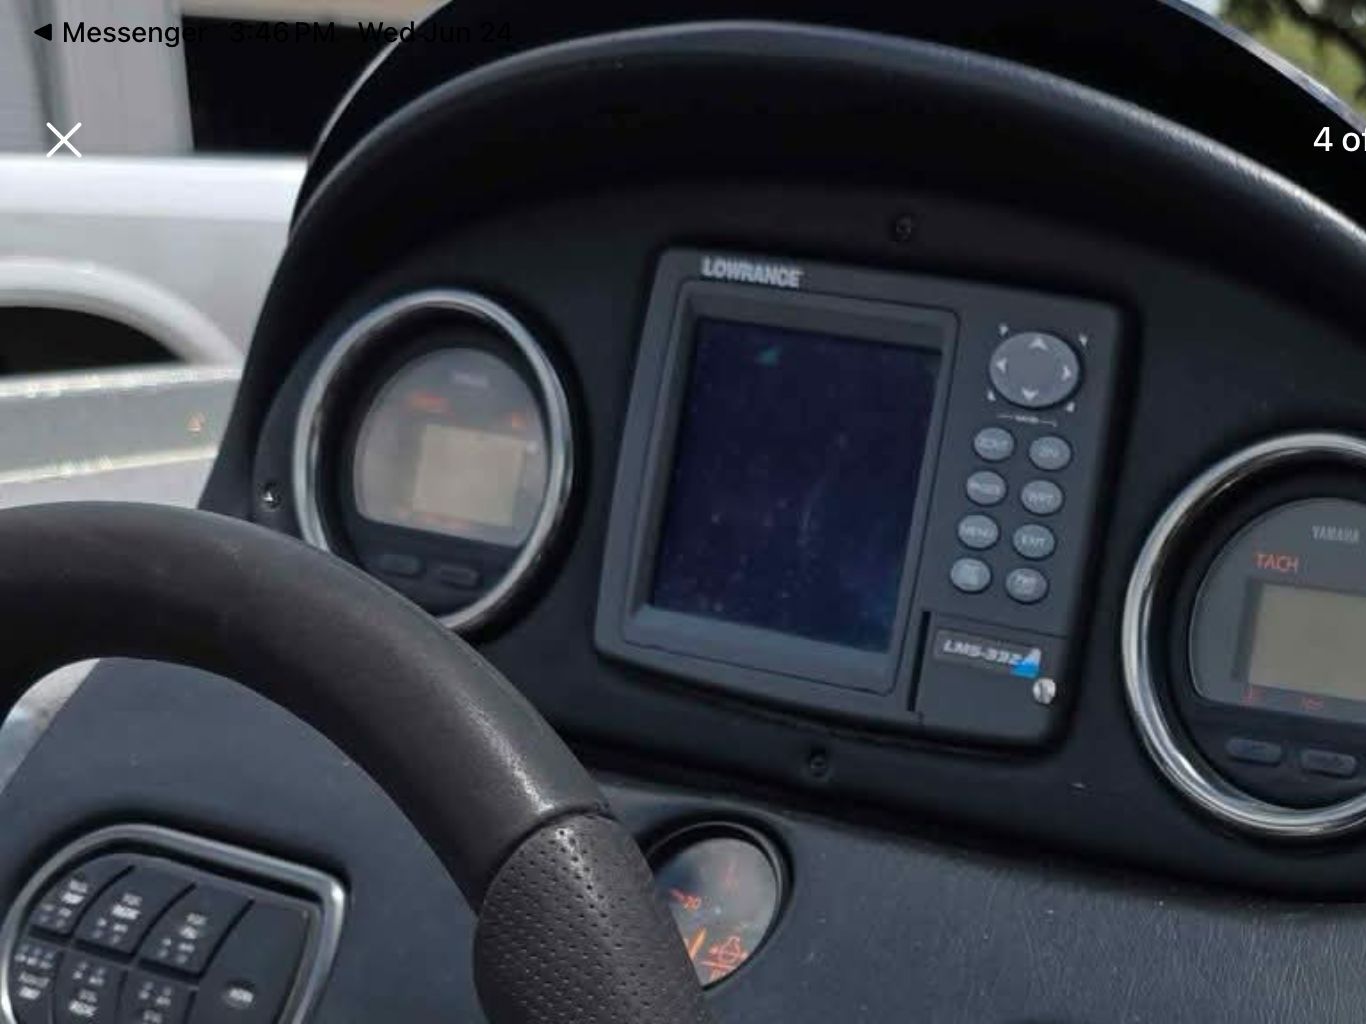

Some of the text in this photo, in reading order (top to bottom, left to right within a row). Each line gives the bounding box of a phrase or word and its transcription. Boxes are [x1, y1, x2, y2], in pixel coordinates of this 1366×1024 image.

[701, 255, 804, 289] LOWRANCE
[1312, 525, 1360, 545] YAMAHA
[1256, 553, 1299, 574] TACH
